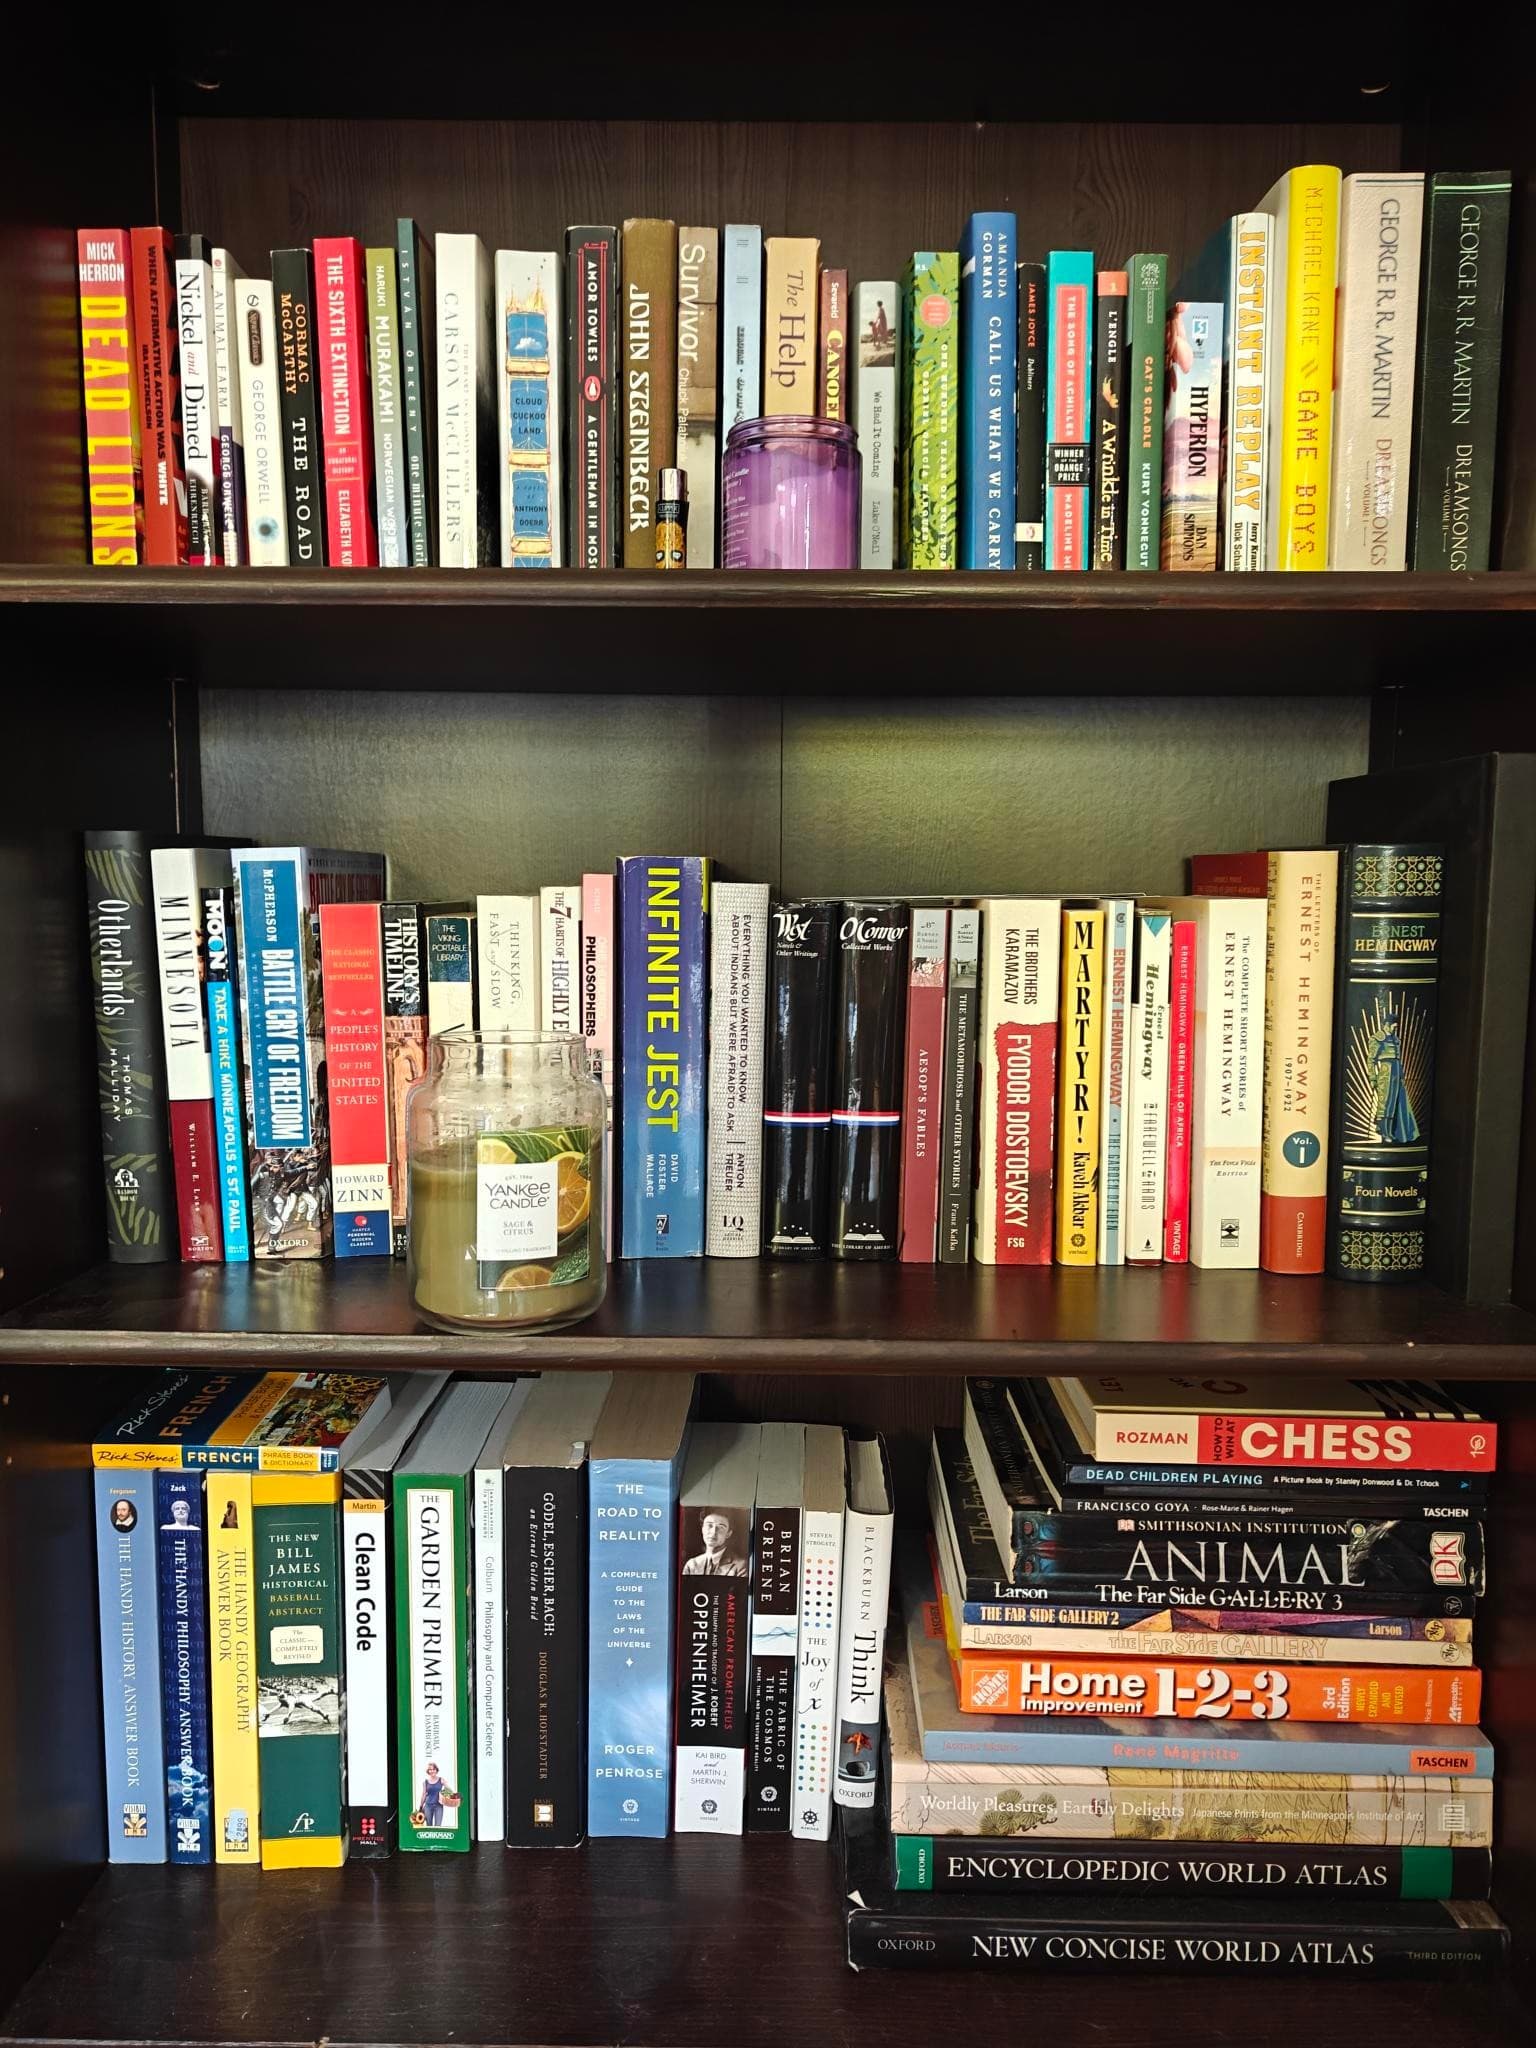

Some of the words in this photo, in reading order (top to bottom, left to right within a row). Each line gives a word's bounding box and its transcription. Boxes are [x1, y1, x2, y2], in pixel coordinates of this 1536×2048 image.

[87, 242, 115, 260] MICK
[80, 264, 124, 281] HERRON
[327, 256, 343, 286] THE
[982, 233, 992, 298] GORMAN
[999, 233, 1007, 298] AMANDA
[587, 261, 597, 302] AMOR
[786, 271, 804, 307] The
[179, 273, 203, 345] Nickel
[328, 292, 345, 336] SIXTH
[679, 244, 705, 362] Survivor
[1237, 232, 1265, 373] INSTANT
[281, 294, 297, 394] McCARTHY
[294, 303, 309, 383] CORMAC
[587, 307, 598, 362] TOWLES
[1108, 311, 1118, 363] L'ENGLE
[771, 312, 806, 388] Help
[188, 352, 196, 375] and
[1143, 357, 1154, 394] CAT'S
[331, 343, 351, 435] EXTINCTION
[515, 398, 542, 406] CLOUD
[184, 384, 207, 459] Dined
[512, 412, 545, 420] CUCKOO
[1143, 398, 1152, 448] CRADLE
[292, 418, 308, 470] THE
[518, 427, 541, 435] LAND
[1190, 387, 1208, 476] HYPERION
[1054, 449, 1084, 458] WINNER
[1235, 386, 1262, 511] REPLAY
[1054, 463, 1083, 472] ORANGE
[1058, 473, 1080, 481] PRIZE
[1141, 463, 1151, 494] KURT
[296, 486, 312, 559] ROAD
[1140, 499, 1150, 567] VONNEGUT
[264, 869, 277, 941] McPHERSON
[437, 934, 461, 942] VIKING
[1026, 928, 1039, 948] THE
[1355, 938, 1437, 952] HEMINGWAY
[1372, 926, 1425, 938] ERNEST
[96, 899, 135, 1017] Otherlands
[432, 944, 467, 952] PORTABLE
[646, 866, 679, 1033] INFINITE
[159, 896, 198, 1048] MINNESOTA
[260, 948, 294, 1005] BATTLE
[1004, 928, 1020, 1004] KARAMAZOV
[1024, 951, 1038, 1004] BROTHERS
[585, 936, 596, 1036] PHILOSOPHERS
[264, 1007, 294, 1041] CRY
[330, 1024, 378, 1034] PEOPLE'S
[1074, 921, 1096, 1143] MARTYR!
[267, 1044, 294, 1064] OF
[330, 1042, 378, 1054] HISTORY
[1007, 1034, 1032, 1104] FYODOR
[109, 1048, 121, 1122] HALLIDAY
[122, 1055, 134, 1116] THOMAS
[331, 1077, 380, 1088] UNITED
[646, 1046, 679, 1132] JEST
[269, 1068, 305, 1139] FREEDOM
[335, 1095, 377, 1105] STATES
[335, 1174, 384, 1185] HOWARD
[658, 1154, 666, 1192] FOSTER
[670, 1154, 679, 1184] DAVID
[1005, 1108, 1031, 1228] DOSTOEVSKY
[338, 1190, 383, 1202] ZINN
[1355, 1185, 1381, 1198] Four
[1385, 1186, 1418, 1199] Novels
[503, 1217, 525, 1228] SAGE
[503, 1228, 534, 1238] CITRUS
[270, 1238, 309, 1247] OXFORD
[1007, 1238, 1024, 1248] FSG
[1116, 1430, 1188, 1445] ROZMAN
[1240, 1422, 1412, 1462] CHESS
[187, 1451, 254, 1463] FRENCH
[271, 1459, 315, 1467] DICTIONARY
[616, 1483, 644, 1495] THE
[1086, 1469, 1126, 1482] DEAD
[1129, 1470, 1200, 1484] CHILDREN
[1204, 1472, 1263, 1486] PLAYING
[352, 1502, 377, 1510] Martin
[419, 1495, 440, 1503] THE
[1076, 1502, 1150, 1512] FRANCISCO
[1155, 1502, 1190, 1512] GOYA
[597, 1508, 639, 1519] ROAD
[643, 1508, 662, 1519] TO
[1423, 1507, 1469, 1518] TASCHEN
[269, 1534, 292, 1542] THE
[296, 1534, 320, 1542] NEW
[599, 1530, 660, 1542] REALITY
[1138, 1520, 1241, 1533] SMITHSONIAN
[1247, 1522, 1348, 1535] INSTITUTION
[276, 1548, 313, 1559] BILL
[354, 1532, 376, 1590] Clean
[420, 1506, 440, 1608] GARDEN
[760, 1521, 774, 1602] GREENE
[780, 1530, 792, 1593] BRIAN
[270, 1562, 321, 1575] JAMES
[860, 1526, 874, 1622] BLACKBURN
[262, 1580, 328, 1590] HISTORICAL
[270, 1594, 322, 1602] BASEBALL
[994, 1583, 1048, 1600] Larson
[1095, 1584, 1132, 1604] The
[1137, 1586, 1166, 1604] Far
[1169, 1587, 1206, 1605] Side
[1332, 1594, 1343, 1610] 3
[268, 1607, 322, 1616] ABSTRACT
[980, 1606, 1003, 1622] THE
[1005, 1606, 1027, 1622] FAR
[1030, 1608, 1056, 1624] SIDE
[1059, 1609, 1109, 1626] GALLERY
[1111, 1612, 1120, 1626] 2
[356, 1598, 378, 1652] Code
[1369, 1623, 1403, 1637] Larson
[807, 1637, 828, 1645] THE
[424, 1618, 442, 1710] PRIMER
[691, 1593, 709, 1729] OPPENHEIMER
[801, 1654, 830, 1671] Joy
[850, 1630, 878, 1704] Think
[809, 1679, 821, 1691] of
[1021, 1662, 1146, 1698] Home
[1021, 1698, 1144, 1714] Improvement
[1154, 1668, 1288, 1719] 1-2-3
[1323, 1686, 1335, 1712] 3rd
[1336, 1678, 1350, 1719] Edition
[604, 1744, 655, 1756] ROGER
[1416, 1756, 1468, 1769] TASCHEN
[595, 1768, 664, 1780] PENROSE
[838, 1789, 873, 1800] OXFORD
[920, 1794, 980, 1816] Worldly
[984, 1797, 1057, 1816] Pleasures,
[1062, 1800, 1116, 1818] Earthly
[1121, 1800, 1184, 1820] Delights
[917, 1849, 926, 1883] OXFORD
[948, 1856, 1169, 1882] ENCYCLOPEDIC
[1178, 1862, 1286, 1884] WORLD
[1296, 1864, 1388, 1886] ATLAS
[878, 1939, 935, 1951] OXFORD
[972, 1934, 1036, 1959] NEW
[1046, 1937, 1166, 1961] CONCISE
[1173, 1938, 1280, 1963] WORLD
[1291, 1941, 1374, 1965] ATLAS
[1407, 1951, 1435, 1961] THIRD
[1440, 1952, 1482, 1962] EDITION
